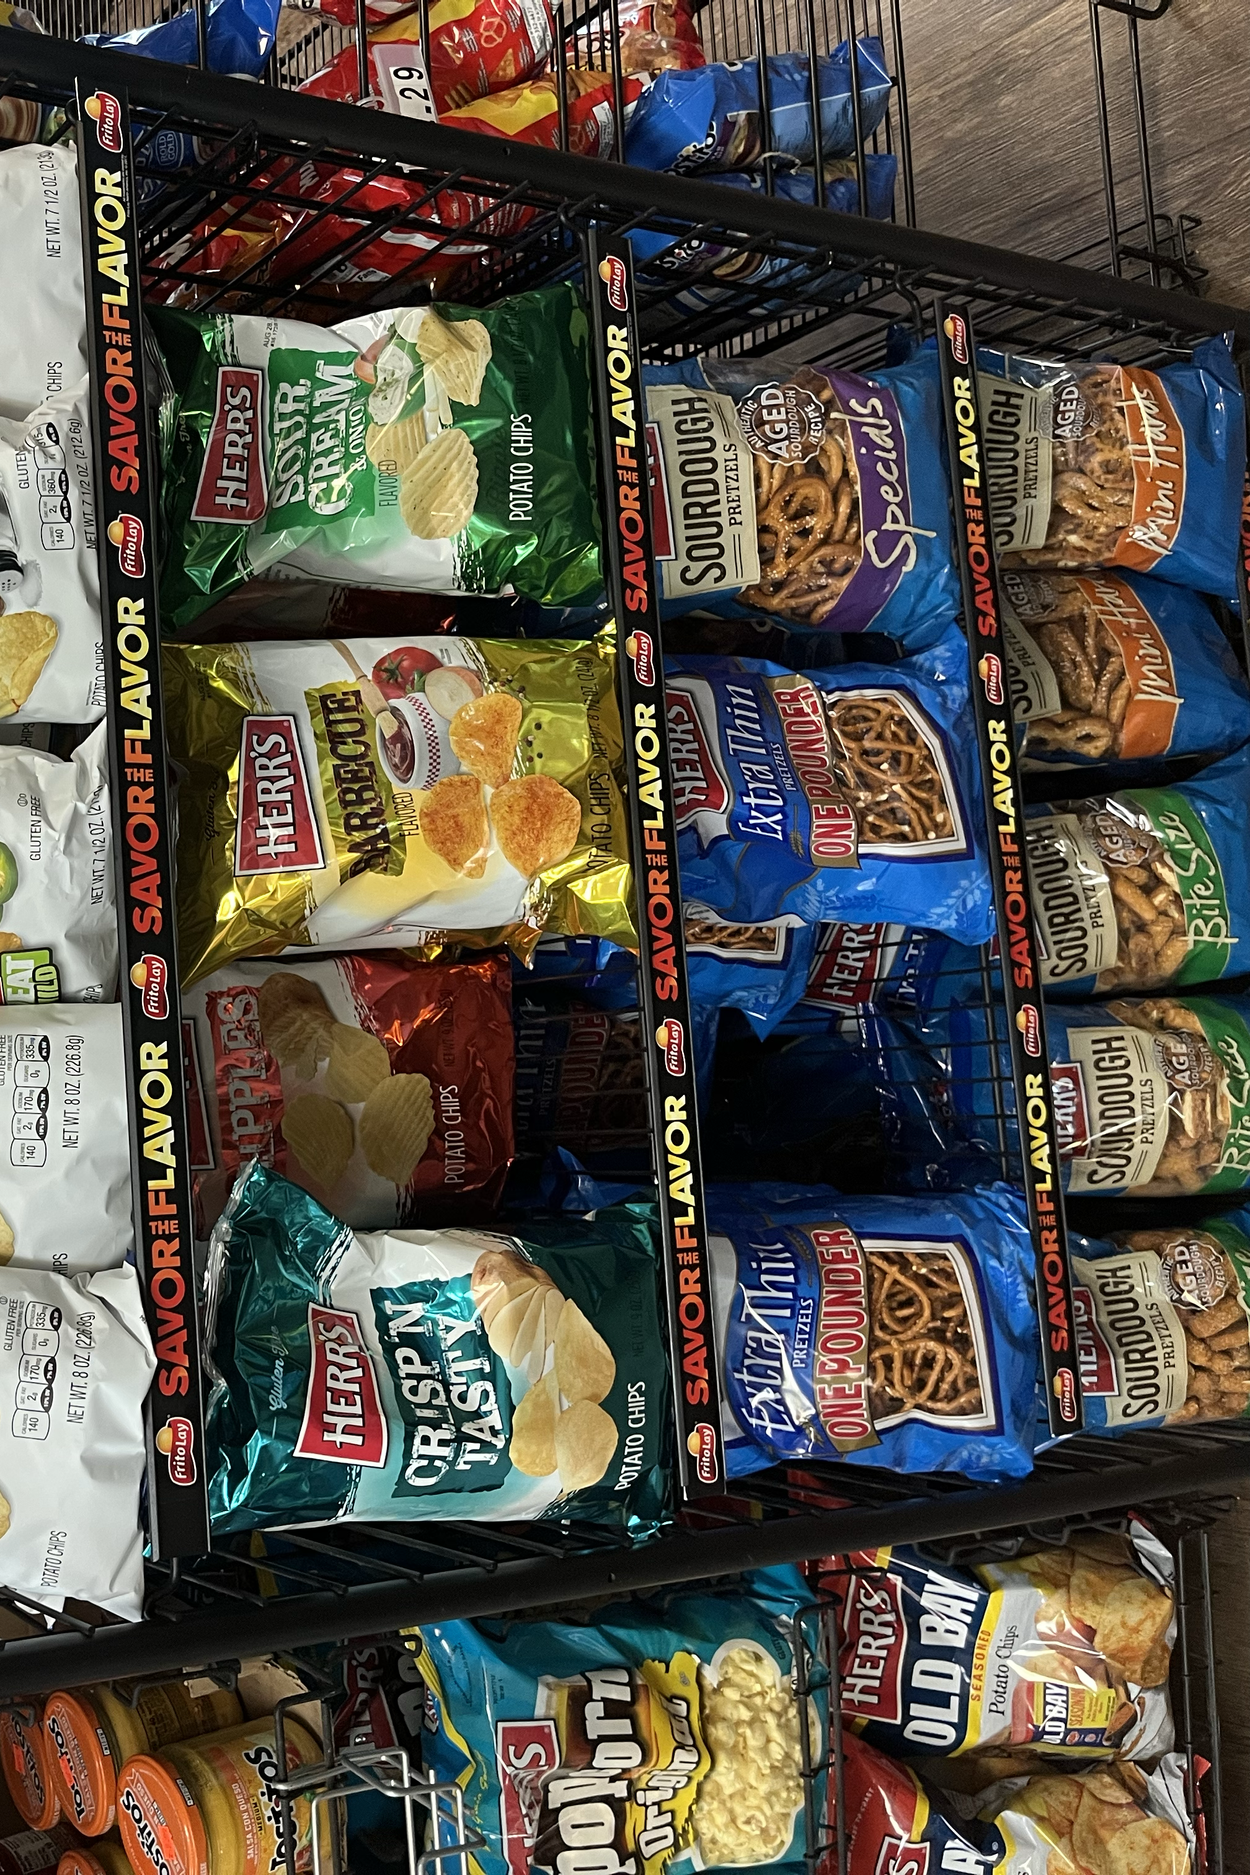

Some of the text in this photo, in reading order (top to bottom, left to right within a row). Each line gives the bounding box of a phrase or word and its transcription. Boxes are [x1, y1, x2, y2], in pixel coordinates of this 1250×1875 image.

[158, 136, 168, 162] ROLD
[166, 132, 176, 160] GOLD
[46, 361, 62, 392] CHIPS
[94, 168, 141, 494] SAVOR FLAVOR
[215, 386, 254, 510] HERR'S
[272, 379, 311, 508] SOUR
[308, 360, 358, 515] CREAM
[762, 388, 787, 458] AGED
[784, 389, 801, 458] SOURDOUGH
[1055, 386, 1078, 438] AGED
[378, 459, 398, 506] FLAVORED
[509, 414, 533, 520] POTATO CHIPS
[607, 325, 647, 613] SAVOR FLAVOR
[671, 397, 726, 586] SOURDOUGH
[723, 443, 742, 526] PRETZELS
[832, 398, 936, 573] Specials
[954, 378, 996, 637] SAVOR FLAVOR
[1024, 436, 1039, 500] PRETZELS
[116, 597, 164, 935] SAVOR FLAVOR
[250, 733, 296, 859] HERR'S
[319, 689, 391, 878] BARBECUE
[392, 792, 419, 837] FLAVORED
[588, 772, 611, 815] CHIPS
[725, 684, 784, 840] Extra Thin
[770, 743, 797, 790] PRETZELS
[774, 684, 855, 857] ONE POUNDER
[30, 795, 42, 860] GLUTEN FREE
[634, 703, 679, 1001] SAVOR FLAVOR
[988, 720, 1032, 989] SAVOR FLAVOR
[1159, 812, 1239, 949] Bite Size
[1027, 825, 1088, 977] SOURDOUGH
[7, 957, 34, 1001] EAT
[64, 1035, 84, 1076] (226.8g)
[65, 1080, 81, 1096] OZ.
[62, 1129, 80, 1148] NET
[65, 1109, 80, 1126] WT.
[440, 1085, 465, 1183] POTATO CHIPS
[1087, 1035, 1135, 1184] SOURDOUGH
[1140, 1079, 1155, 1144] PRETZELS
[139, 1041, 190, 1396] SAVOR FLAVOR
[665, 1096, 710, 1406] SAVOR FLAVOR
[1026, 1074, 1069, 1352] SAVOR FLAVOR
[739, 1242, 795, 1324] Thin
[792, 1298, 814, 1367] PRETZELS
[811, 1228, 867, 1439] ONE POUNDER
[1145, 1303, 1175, 1369] PRETZELS
[268, 1359, 287, 1411] Gluten
[317, 1322, 363, 1448] HERR'S
[437, 1315, 506, 1471] TASTY
[1095, 1265, 1160, 1418] SOURDOUGH
[394, 1347, 457, 1487] CRISP
[614, 1381, 645, 1490] POTATO CHIPS
[41, 1531, 67, 1588] POTATO CHIPS
[842, 1586, 897, 1705] HERR'S
[903, 1569, 980, 1746] OLD BAY
[970, 1629, 992, 1702] SEASONED
[988, 1625, 1019, 1716] Potato Chips
[636, 1696, 700, 1858] Original
[1046, 1723, 1065, 1744] OLD
[232, 1783, 254, 1859] SALSA CON QUESO
